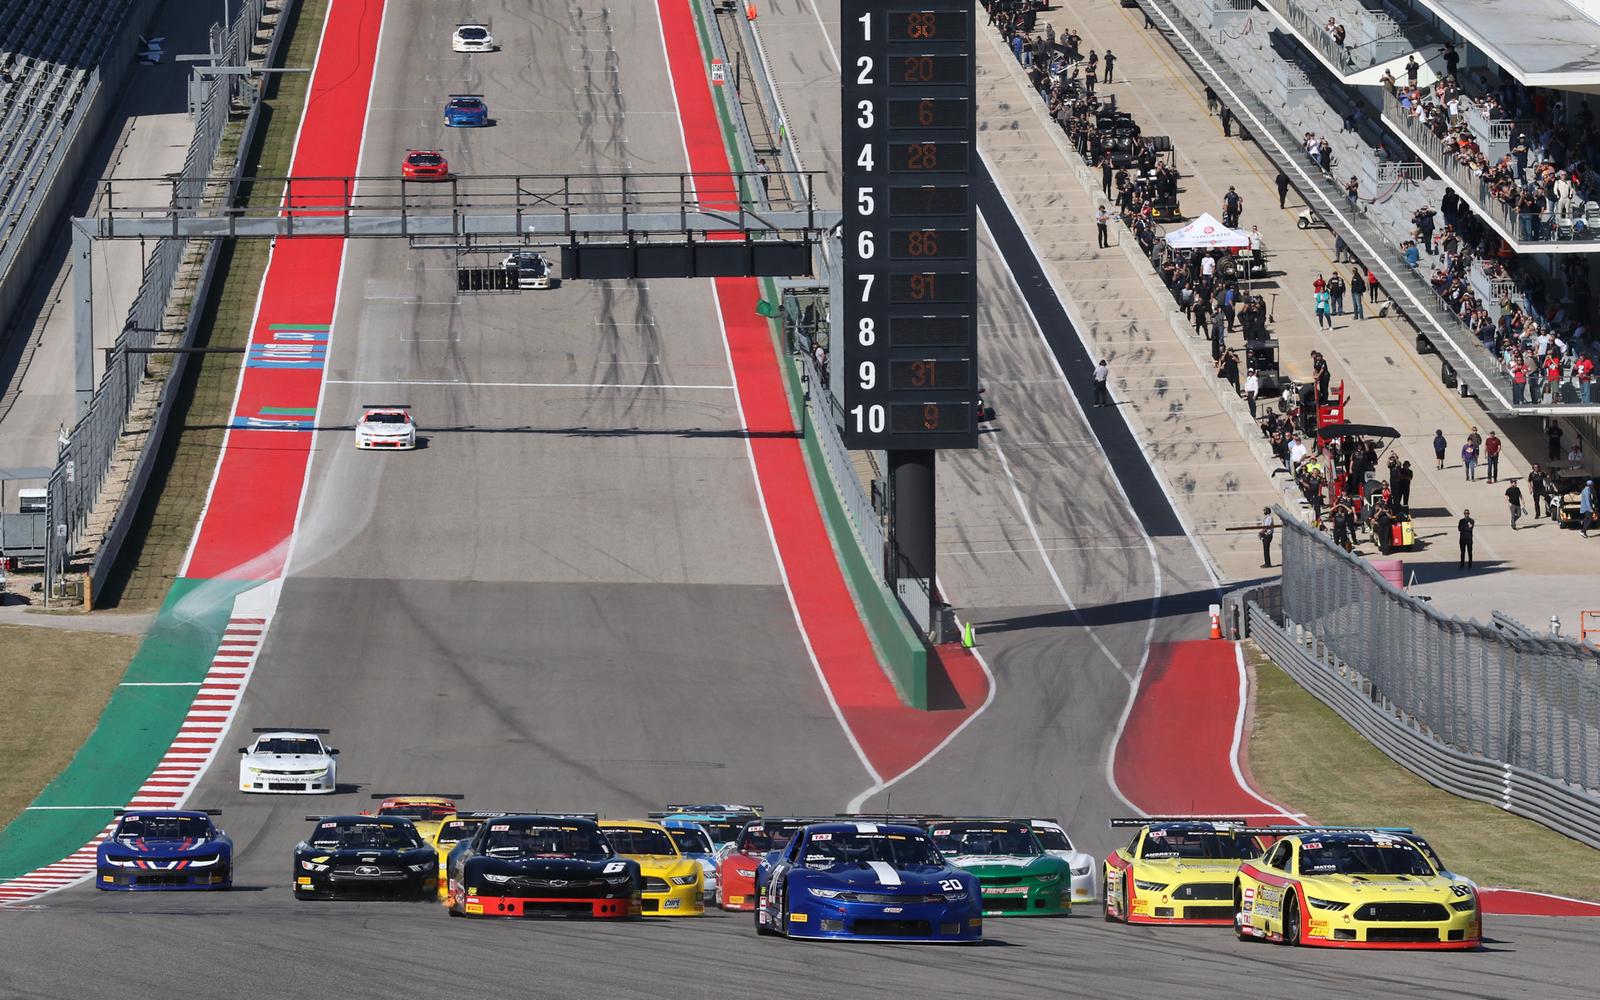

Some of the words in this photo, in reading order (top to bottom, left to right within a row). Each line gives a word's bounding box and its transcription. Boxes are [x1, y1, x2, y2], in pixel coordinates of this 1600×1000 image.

[858, 12, 871, 41] 1
[908, 12, 936, 38] 88
[857, 56, 874, 85] 2
[904, 57, 934, 81] 20
[857, 100, 874, 129] 3
[919, 101, 934, 126] 6
[857, 143, 874, 171] 4
[908, 143, 937, 169] 28
[858, 187, 875, 215] 5
[858, 231, 875, 259] 6
[908, 231, 938, 256] 86
[858, 274, 875, 302] 7
[911, 274, 937, 299] 91
[859, 317, 875, 346] 8
[859, 361, 876, 390] 9
[911, 362, 937, 387] 31
[850, 404, 886, 433] 10
[924, 405, 939, 430] 9
[603, 862, 627, 873] 6
[938, 879, 963, 892] 20
